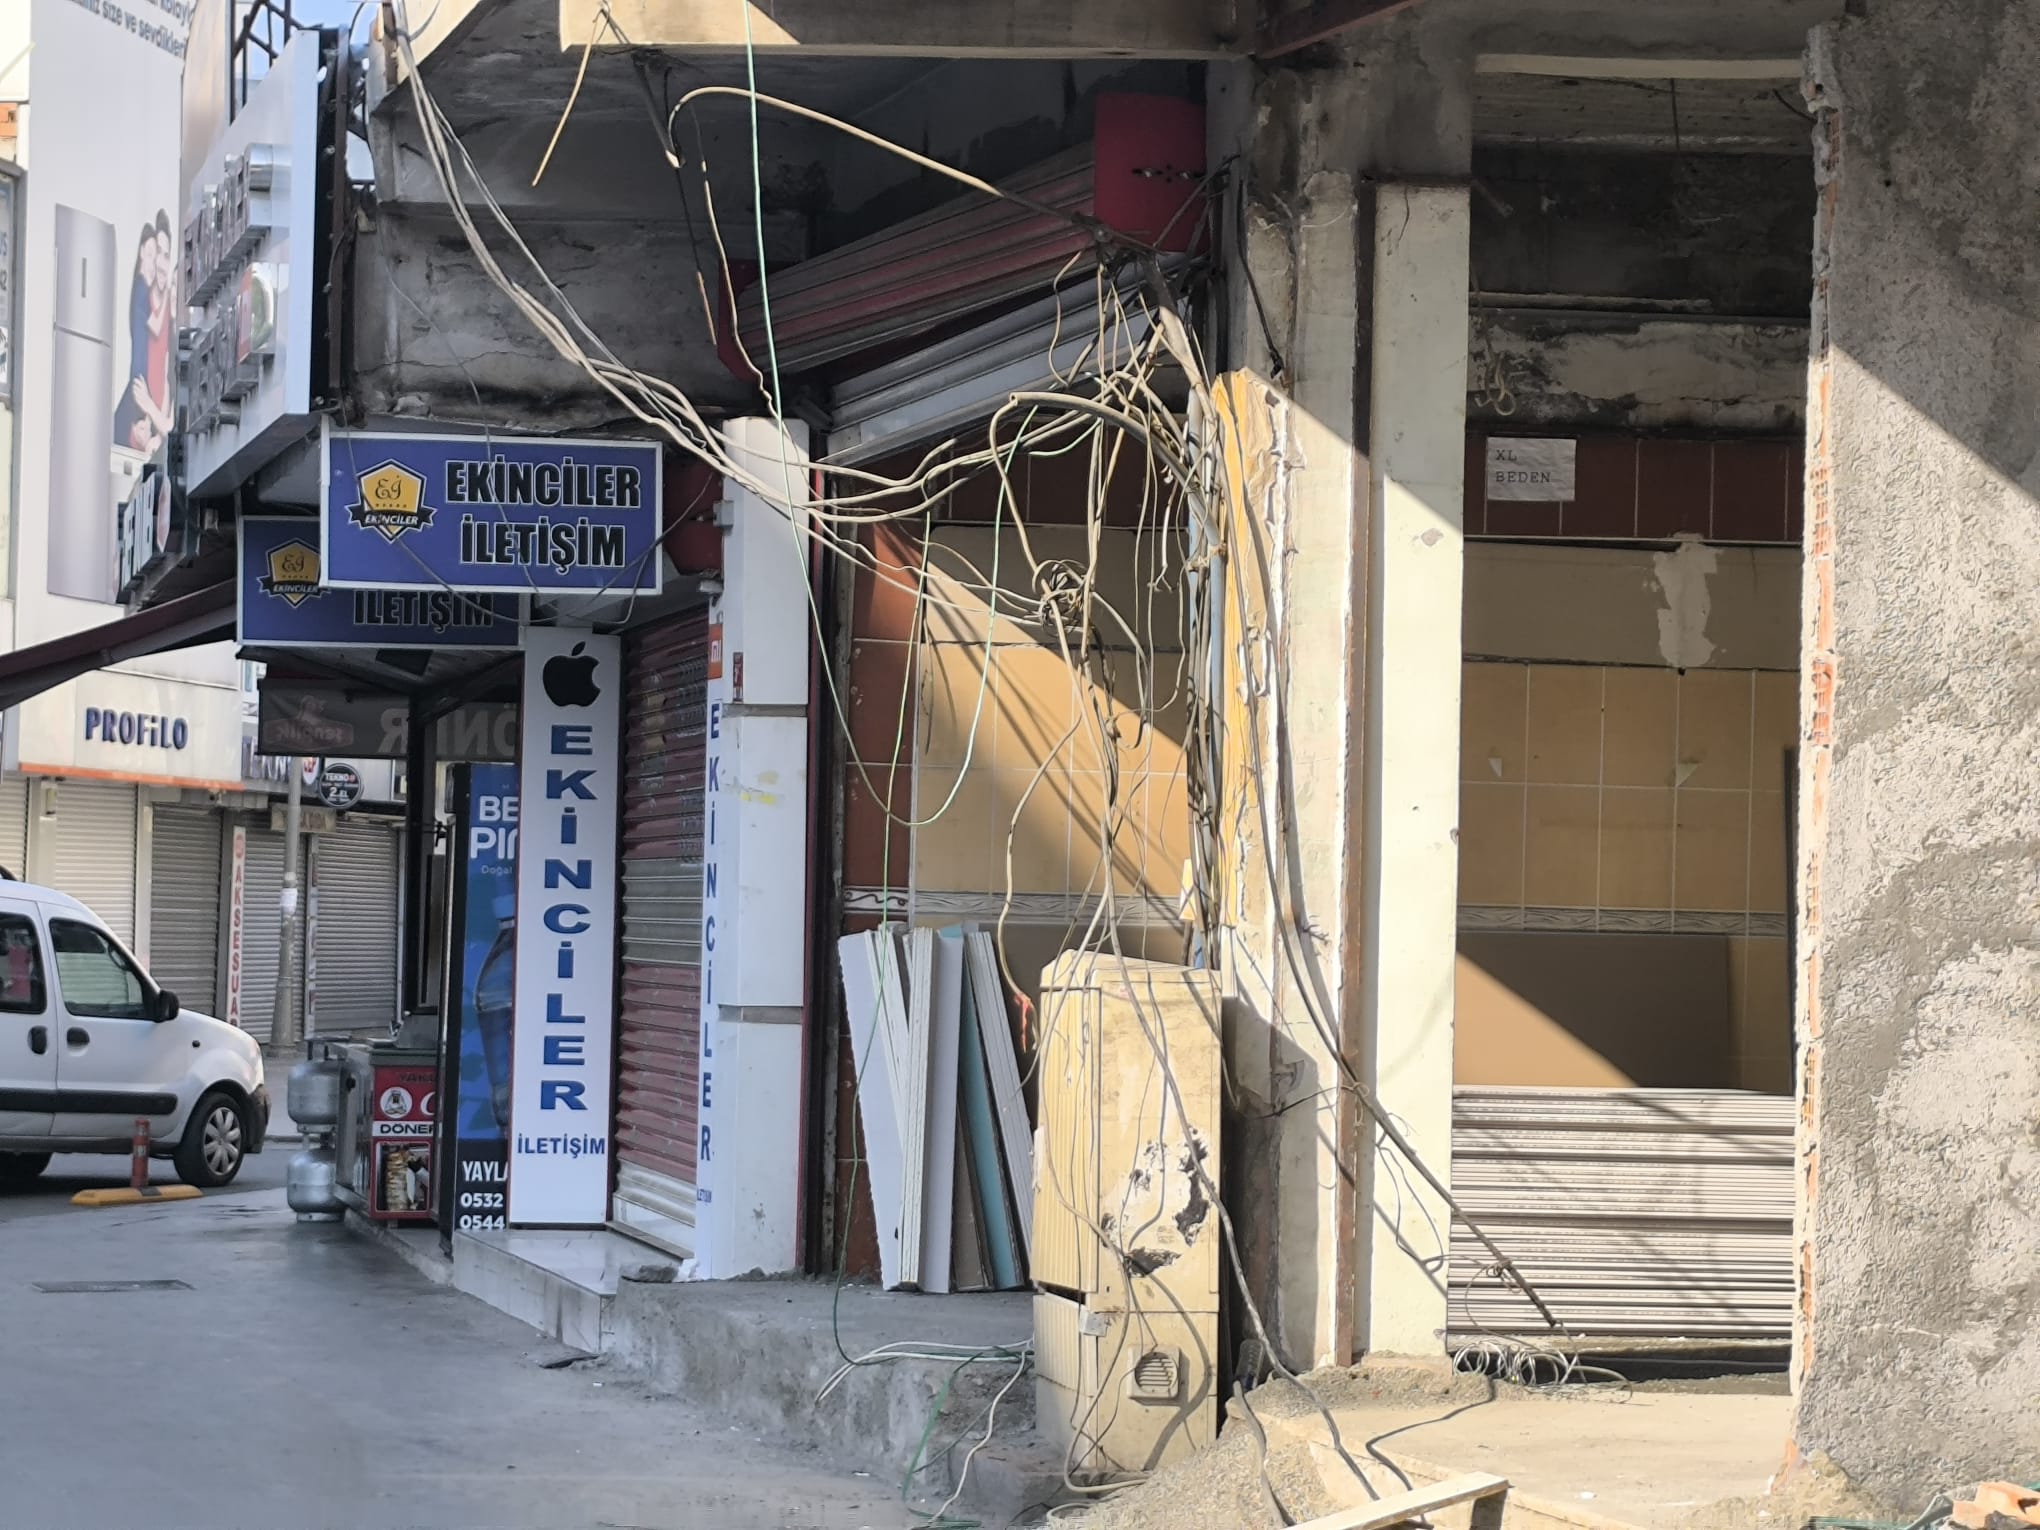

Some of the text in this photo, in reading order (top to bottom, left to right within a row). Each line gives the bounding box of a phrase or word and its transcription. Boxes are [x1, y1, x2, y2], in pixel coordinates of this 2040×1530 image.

[1495, 449, 1517, 461] XL
[444, 454, 641, 508] EKİNCİLER
[1495, 471, 1550, 483] BEDEN
[364, 513, 419, 526] EKİNCİLER
[459, 513, 626, 576] İLETİŞİM
[540, 725, 598, 1110] EKİNCİLER
[701, 704, 720, 1160] EKİNCİLER
[516, 1133, 606, 1159] İLETİŞİM
[460, 1192, 504, 1208] 0532
[459, 1214, 506, 1230] 0544
